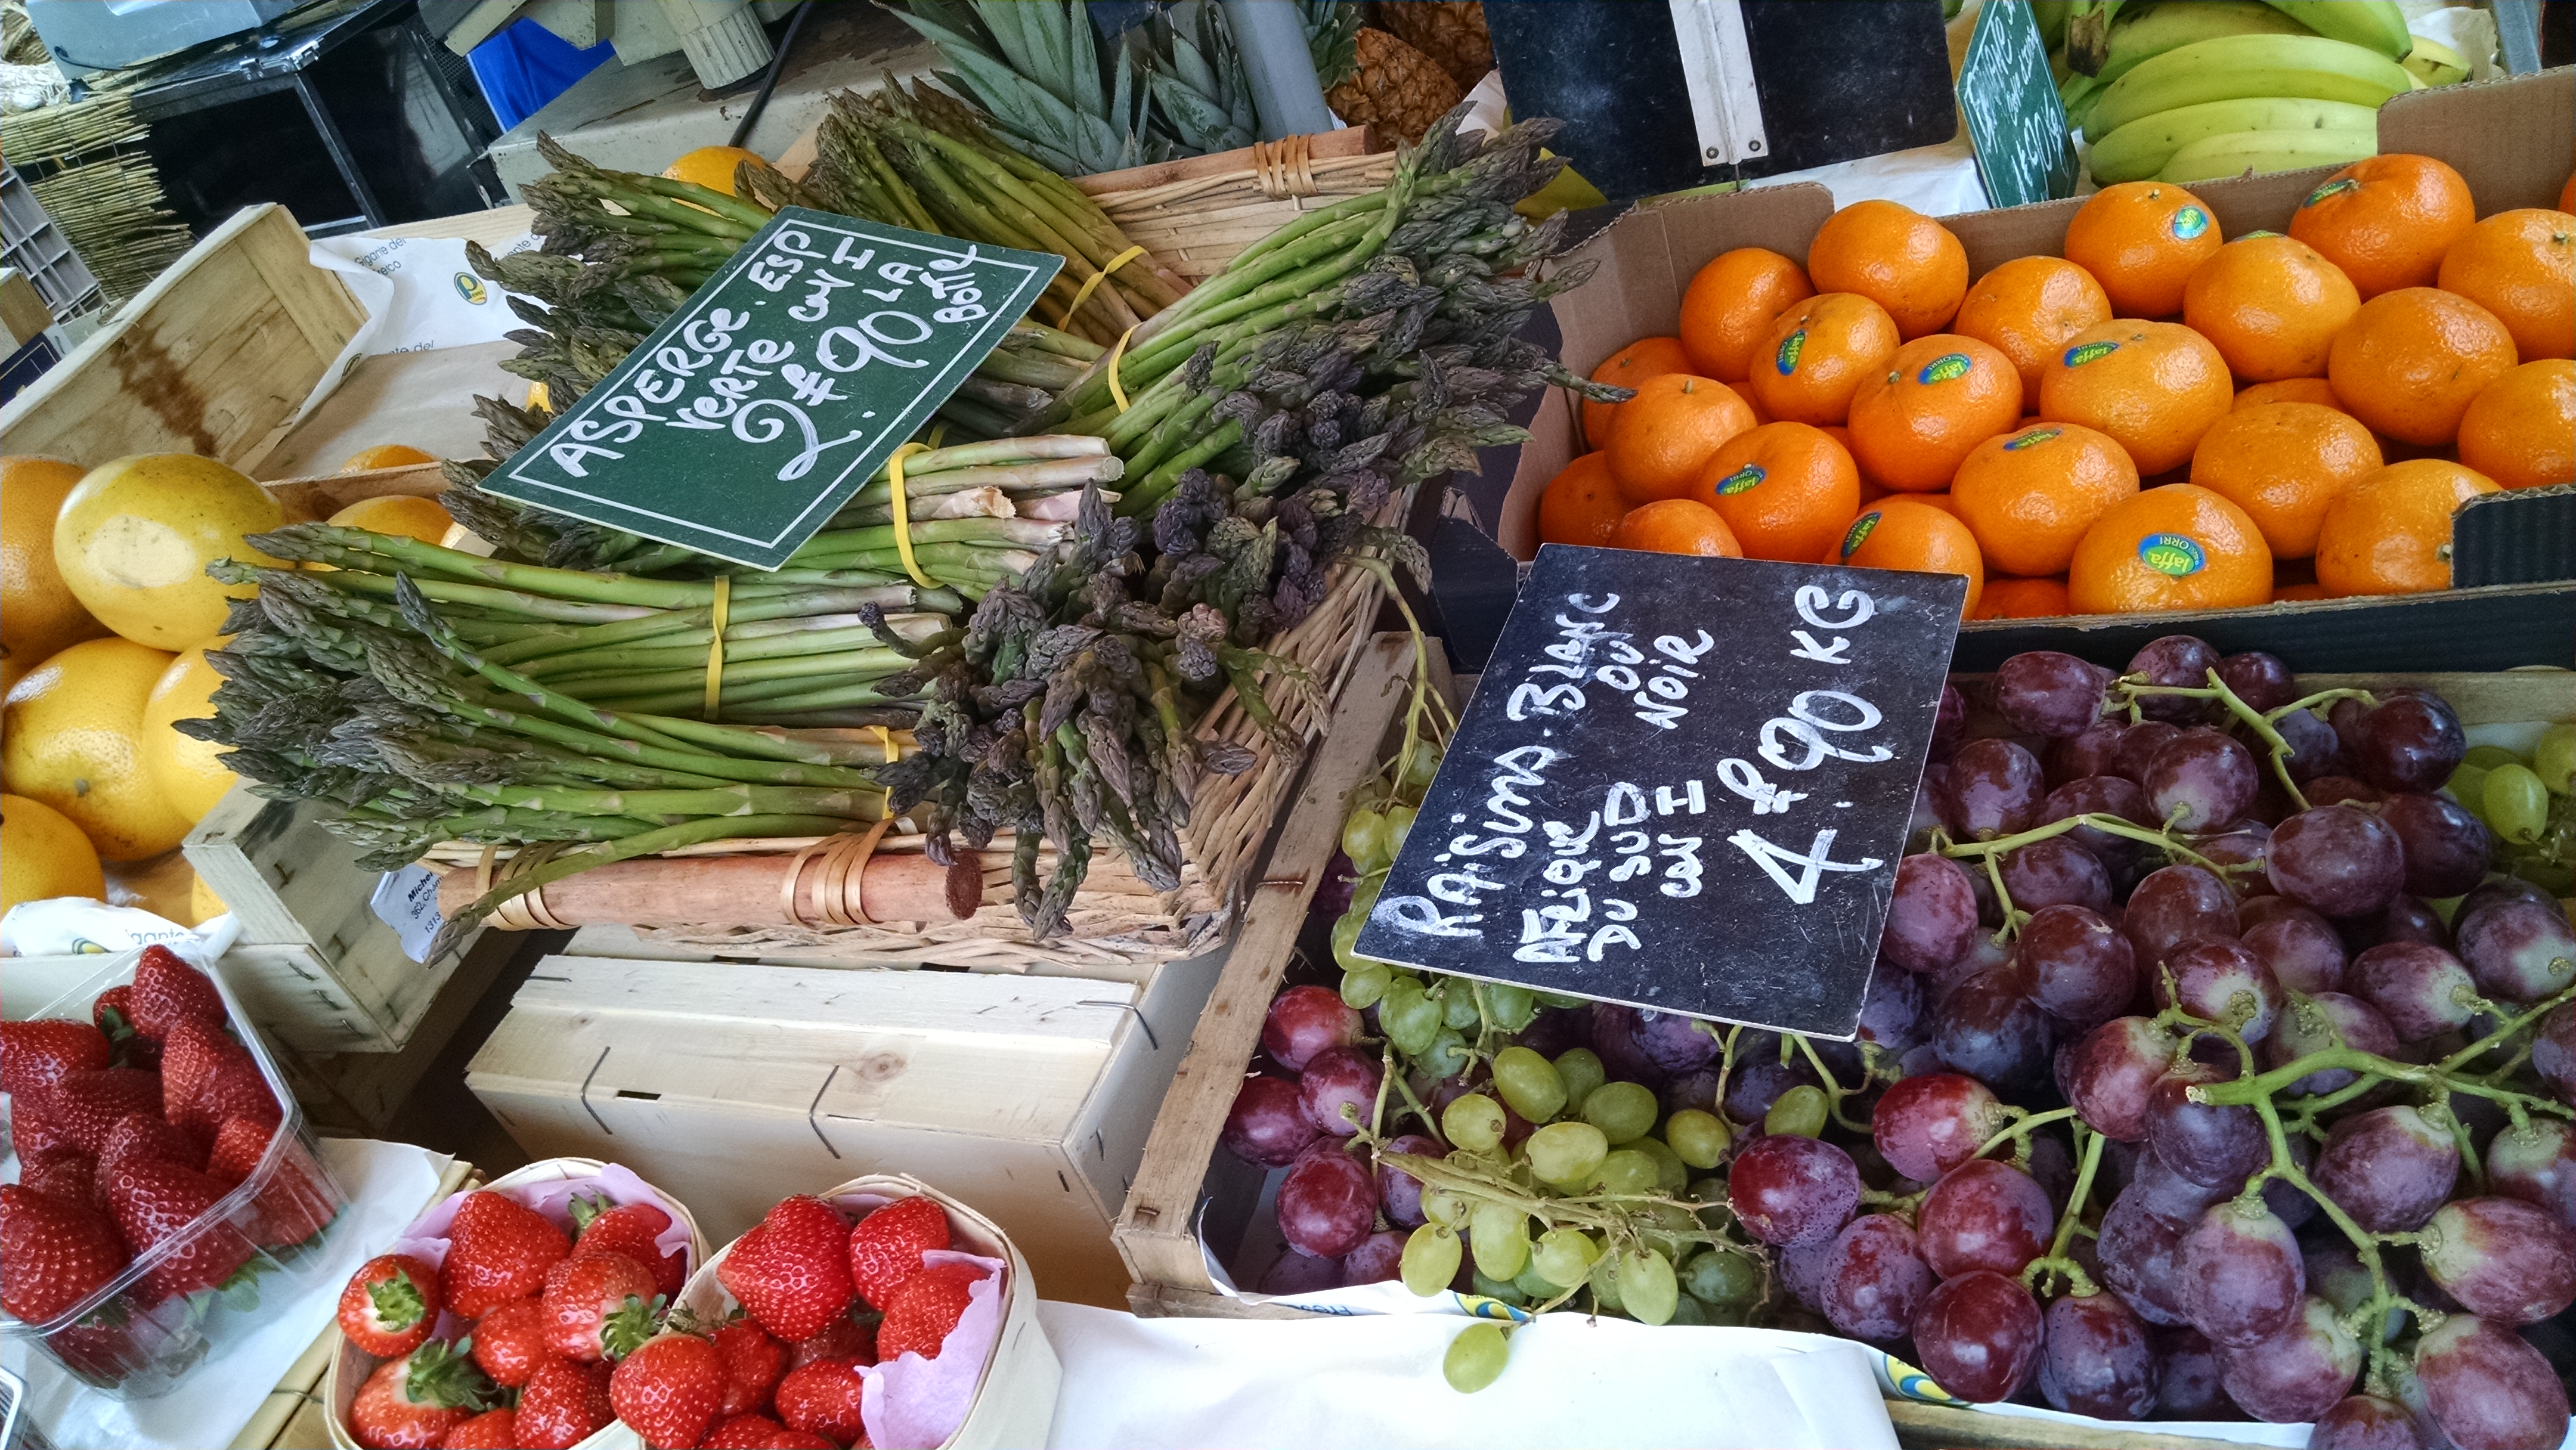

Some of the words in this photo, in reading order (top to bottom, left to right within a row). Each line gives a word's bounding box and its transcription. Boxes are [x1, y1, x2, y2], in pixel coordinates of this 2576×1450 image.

[747, 228, 826, 292] ESP
[862, 261, 924, 302] LA
[1788, 337, 1804, 364] Jaffa
[1927, 356, 1952, 370] ORRI
[2074, 346, 2108, 363] Jaffa
[1931, 361, 1964, 380] Jaffa
[1726, 477, 1757, 494] Jaffa
[1729, 470, 1753, 482] ORRI
[1852, 519, 1876, 548] Jaffa
[2159, 536, 2190, 550] ORRI
[2150, 552, 2191, 573] Jaffa
[1789, 583, 1877, 665] KG
[1506, 591, 1621, 723] BLANC
[1595, 638, 1647, 693] OU
[1603, 780, 1652, 883] SUD
[1586, 898, 1642, 962] DU
